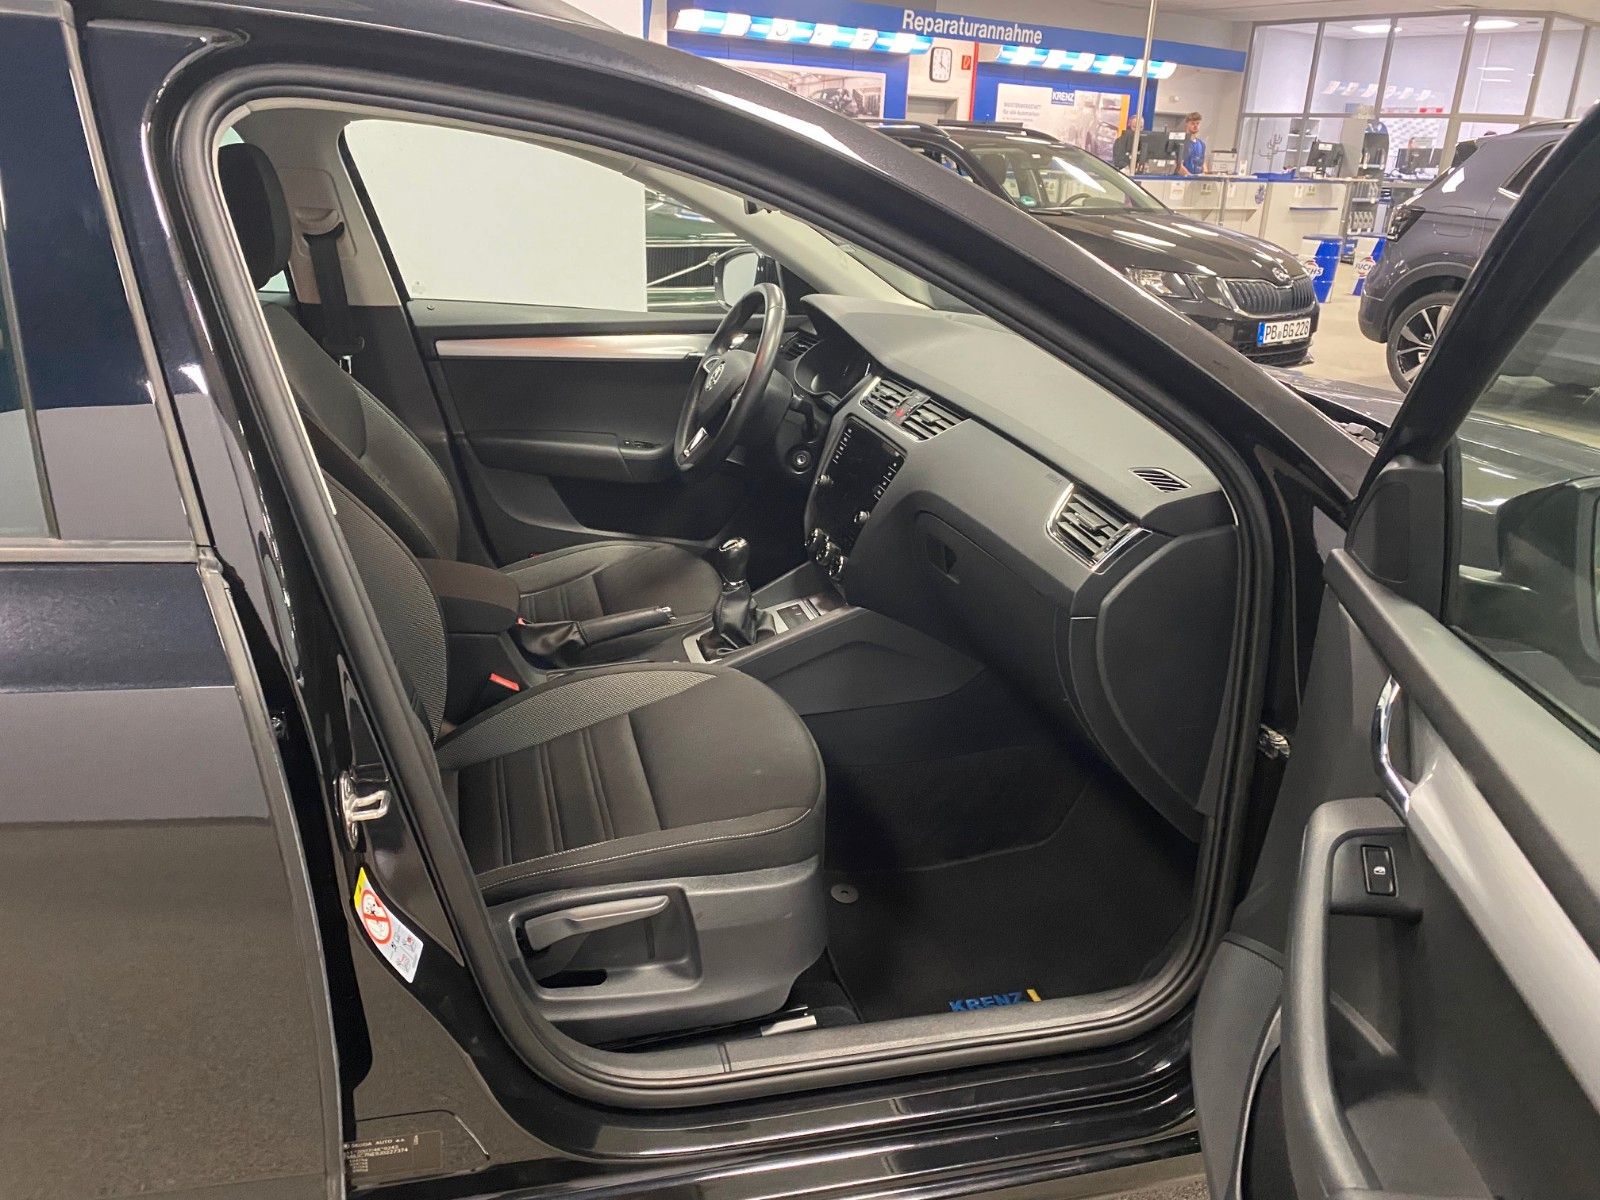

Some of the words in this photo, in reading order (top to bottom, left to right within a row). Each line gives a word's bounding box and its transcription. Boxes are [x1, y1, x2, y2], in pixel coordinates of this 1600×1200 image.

[902, 9, 1043, 45] Reparaturannahme
[1052, 92, 1075, 102] KRENZ
[1265, 324, 1278, 340] PB
[949, 991, 1022, 1013] KRENZ
